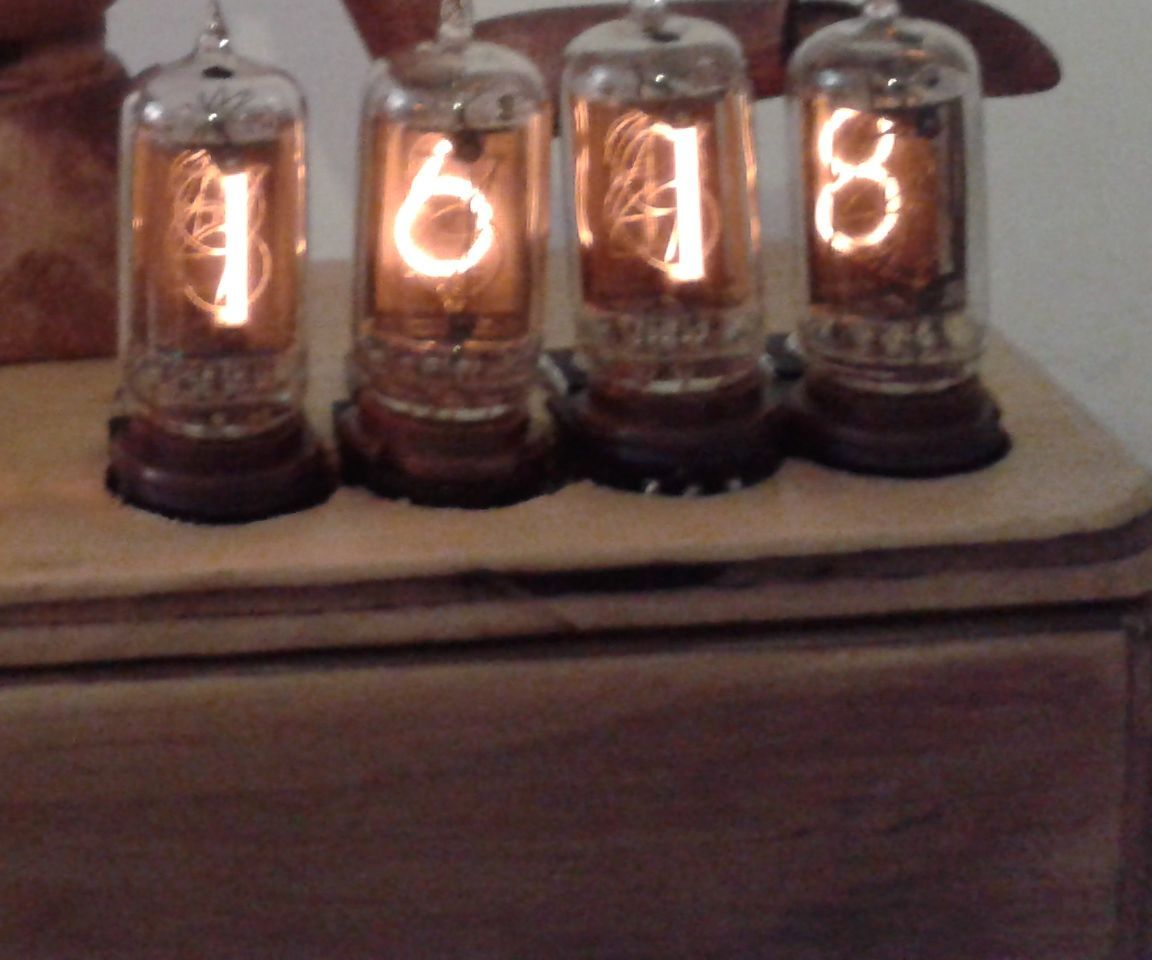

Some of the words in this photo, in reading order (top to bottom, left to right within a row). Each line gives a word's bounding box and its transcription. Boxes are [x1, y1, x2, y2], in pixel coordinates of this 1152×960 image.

[211, 171, 250, 327] 1
[391, 137, 496, 279] 6
[645, 122, 706, 283] 1
[813, 106, 902, 253] 8
